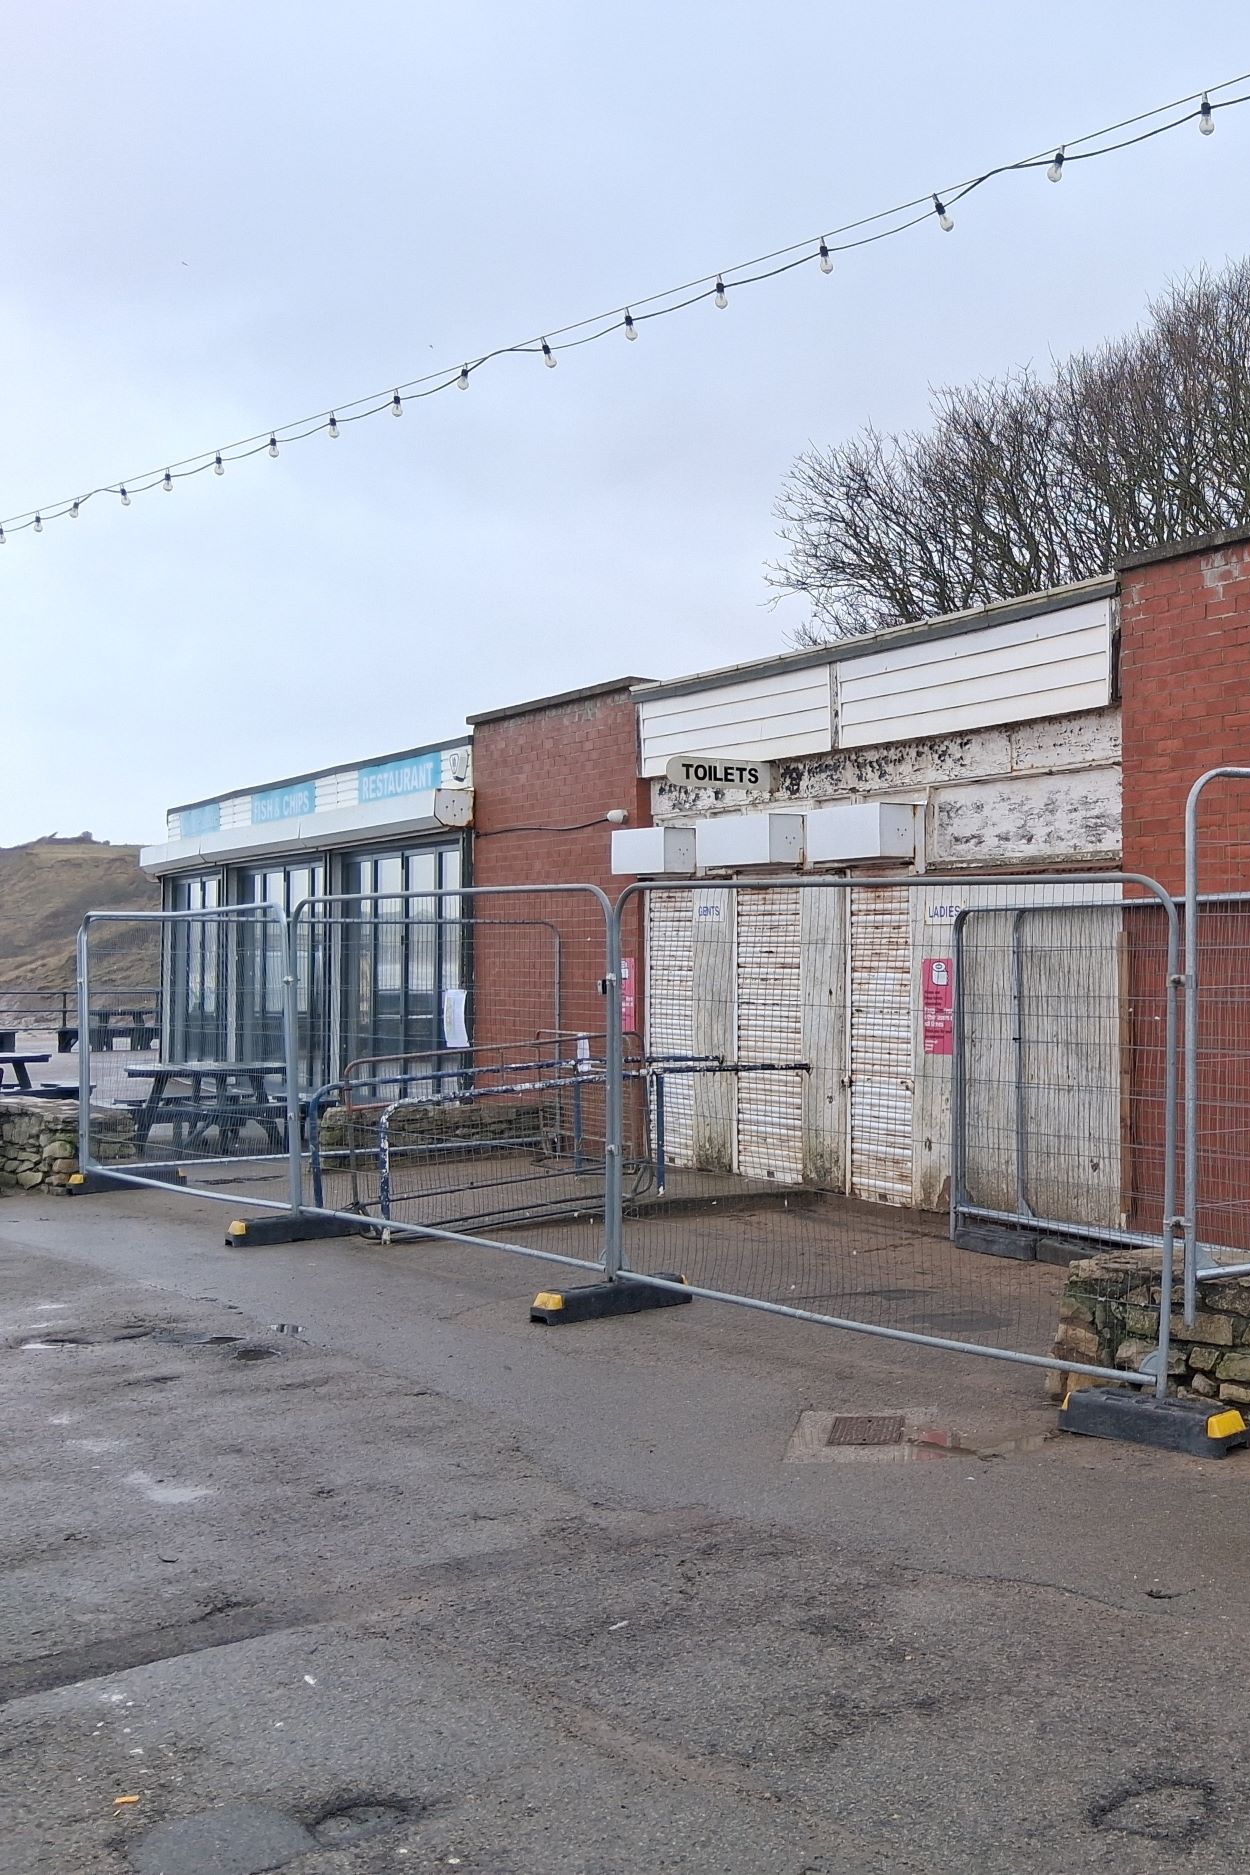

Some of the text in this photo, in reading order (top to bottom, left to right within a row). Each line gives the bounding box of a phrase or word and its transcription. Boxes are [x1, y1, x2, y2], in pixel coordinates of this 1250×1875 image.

[362, 762, 434, 800] RESTAURANT
[681, 763, 759, 784] TOILETS
[253, 791, 309, 823] FISH & CHIPS
[698, 905, 720, 917] GENTS
[928, 905, 961, 918] LADIES
